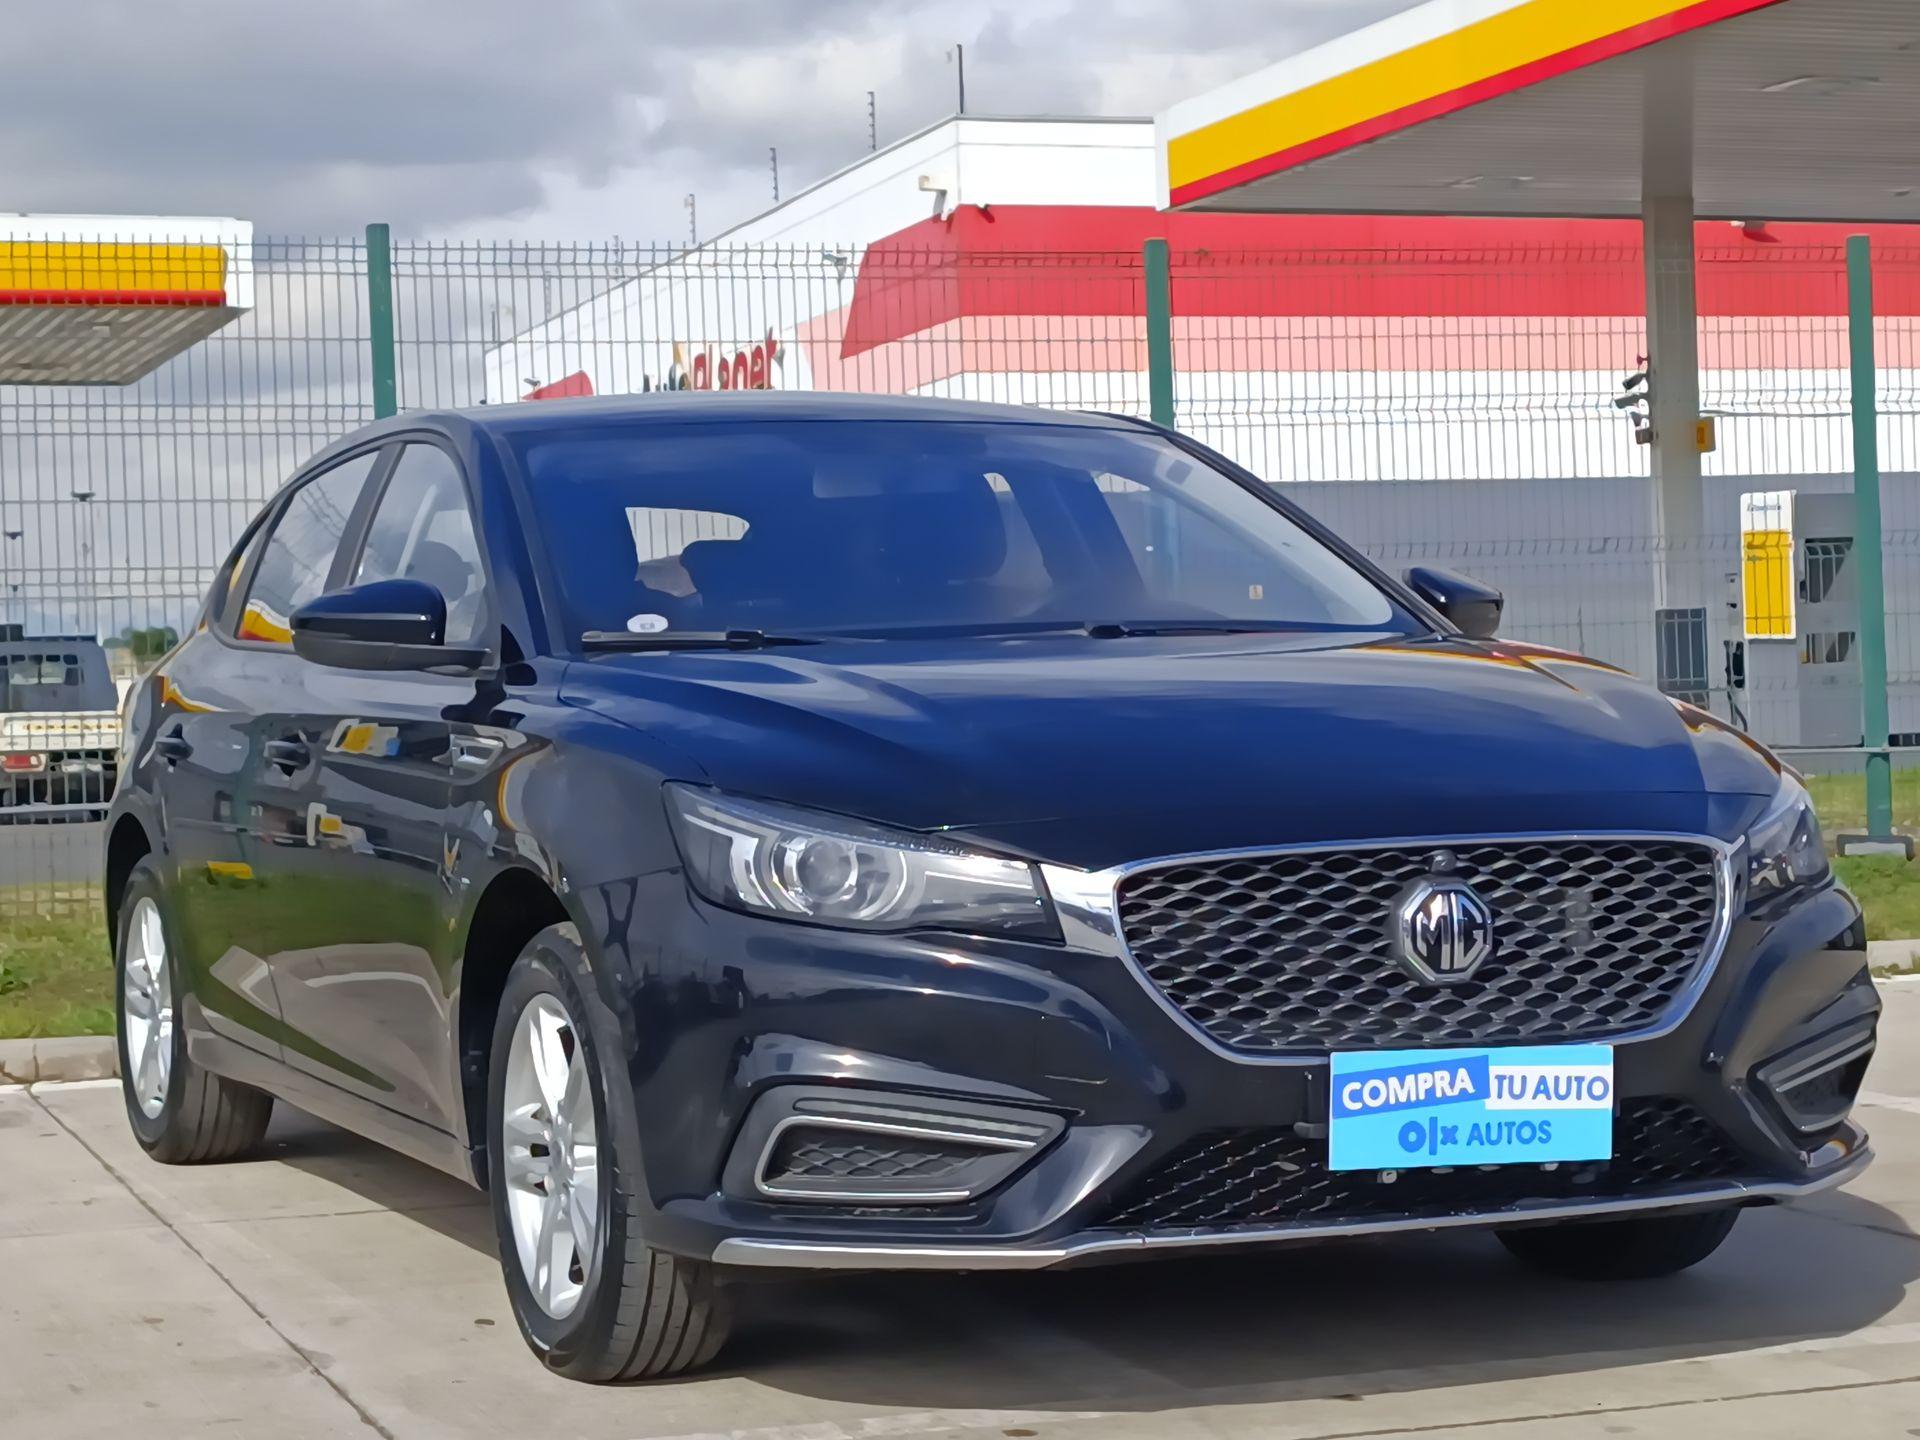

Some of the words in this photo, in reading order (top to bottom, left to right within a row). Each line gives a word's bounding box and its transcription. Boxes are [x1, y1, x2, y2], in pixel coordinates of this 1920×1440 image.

[1414, 890, 1487, 971] MG
[1341, 1067, 1476, 1110] COMPRA
[1494, 1074, 1527, 1101] TU
[1532, 1074, 1610, 1101] AUTO
[1466, 1120, 1552, 1147] AUTOS
